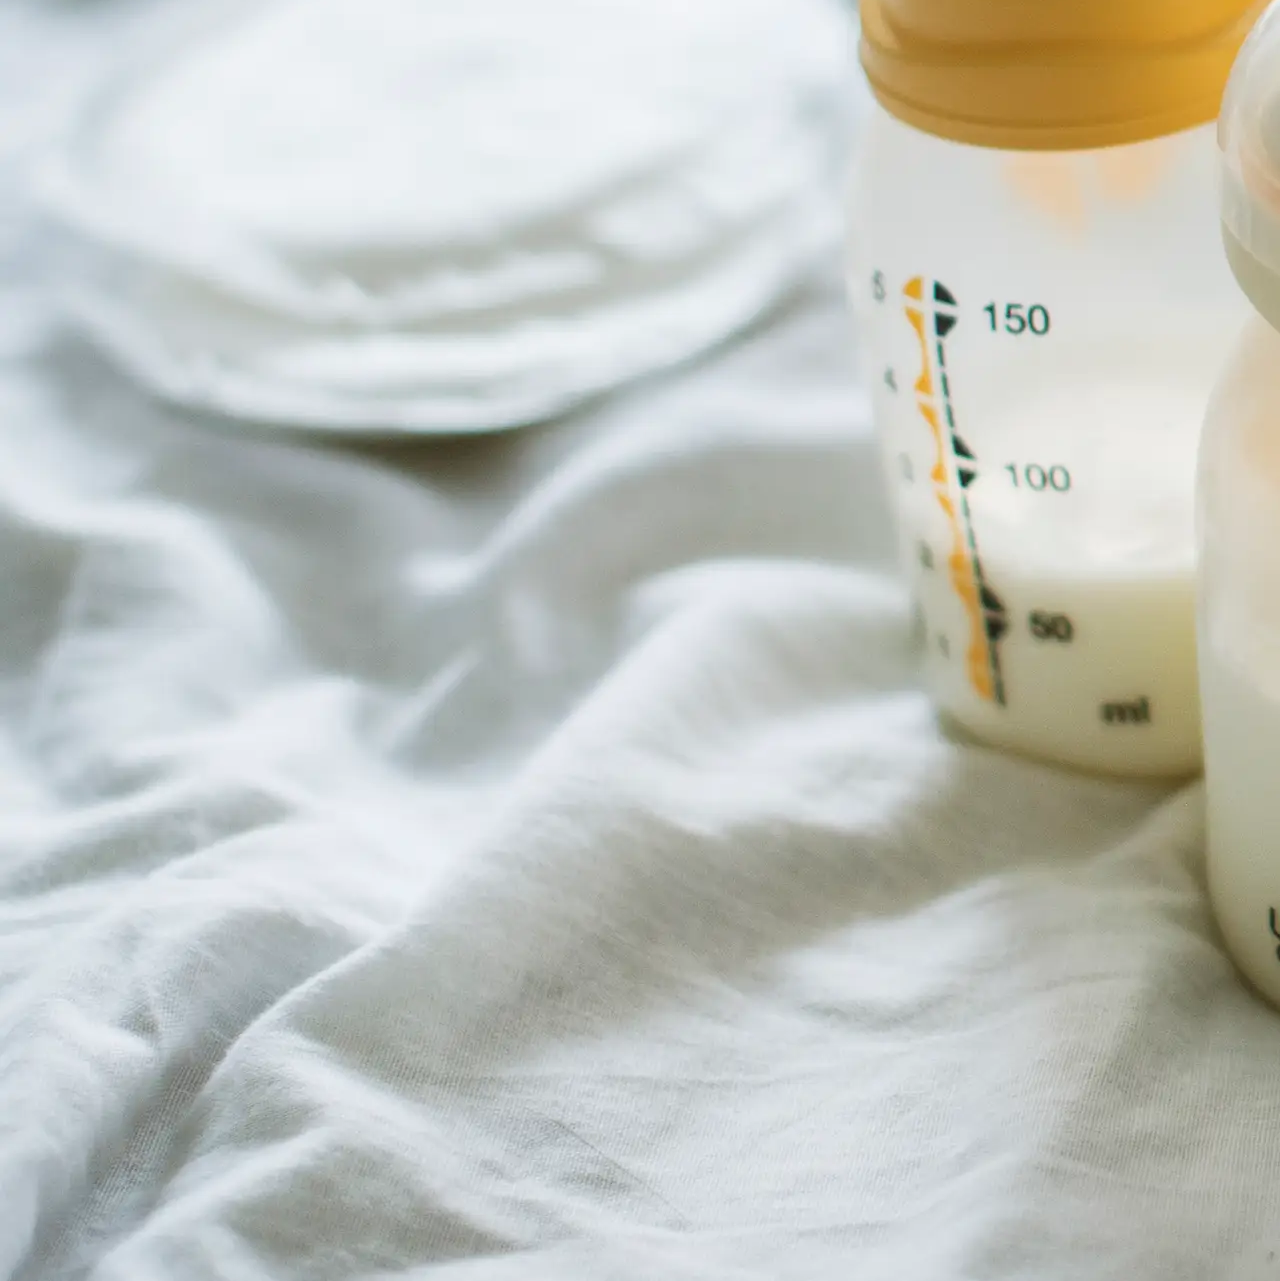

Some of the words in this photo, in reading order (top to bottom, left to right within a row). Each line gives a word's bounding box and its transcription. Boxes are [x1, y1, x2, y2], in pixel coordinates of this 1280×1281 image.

[983, 303, 1051, 335] 150
[1003, 462, 1071, 493] 100
[1102, 694, 1151, 724] ml
